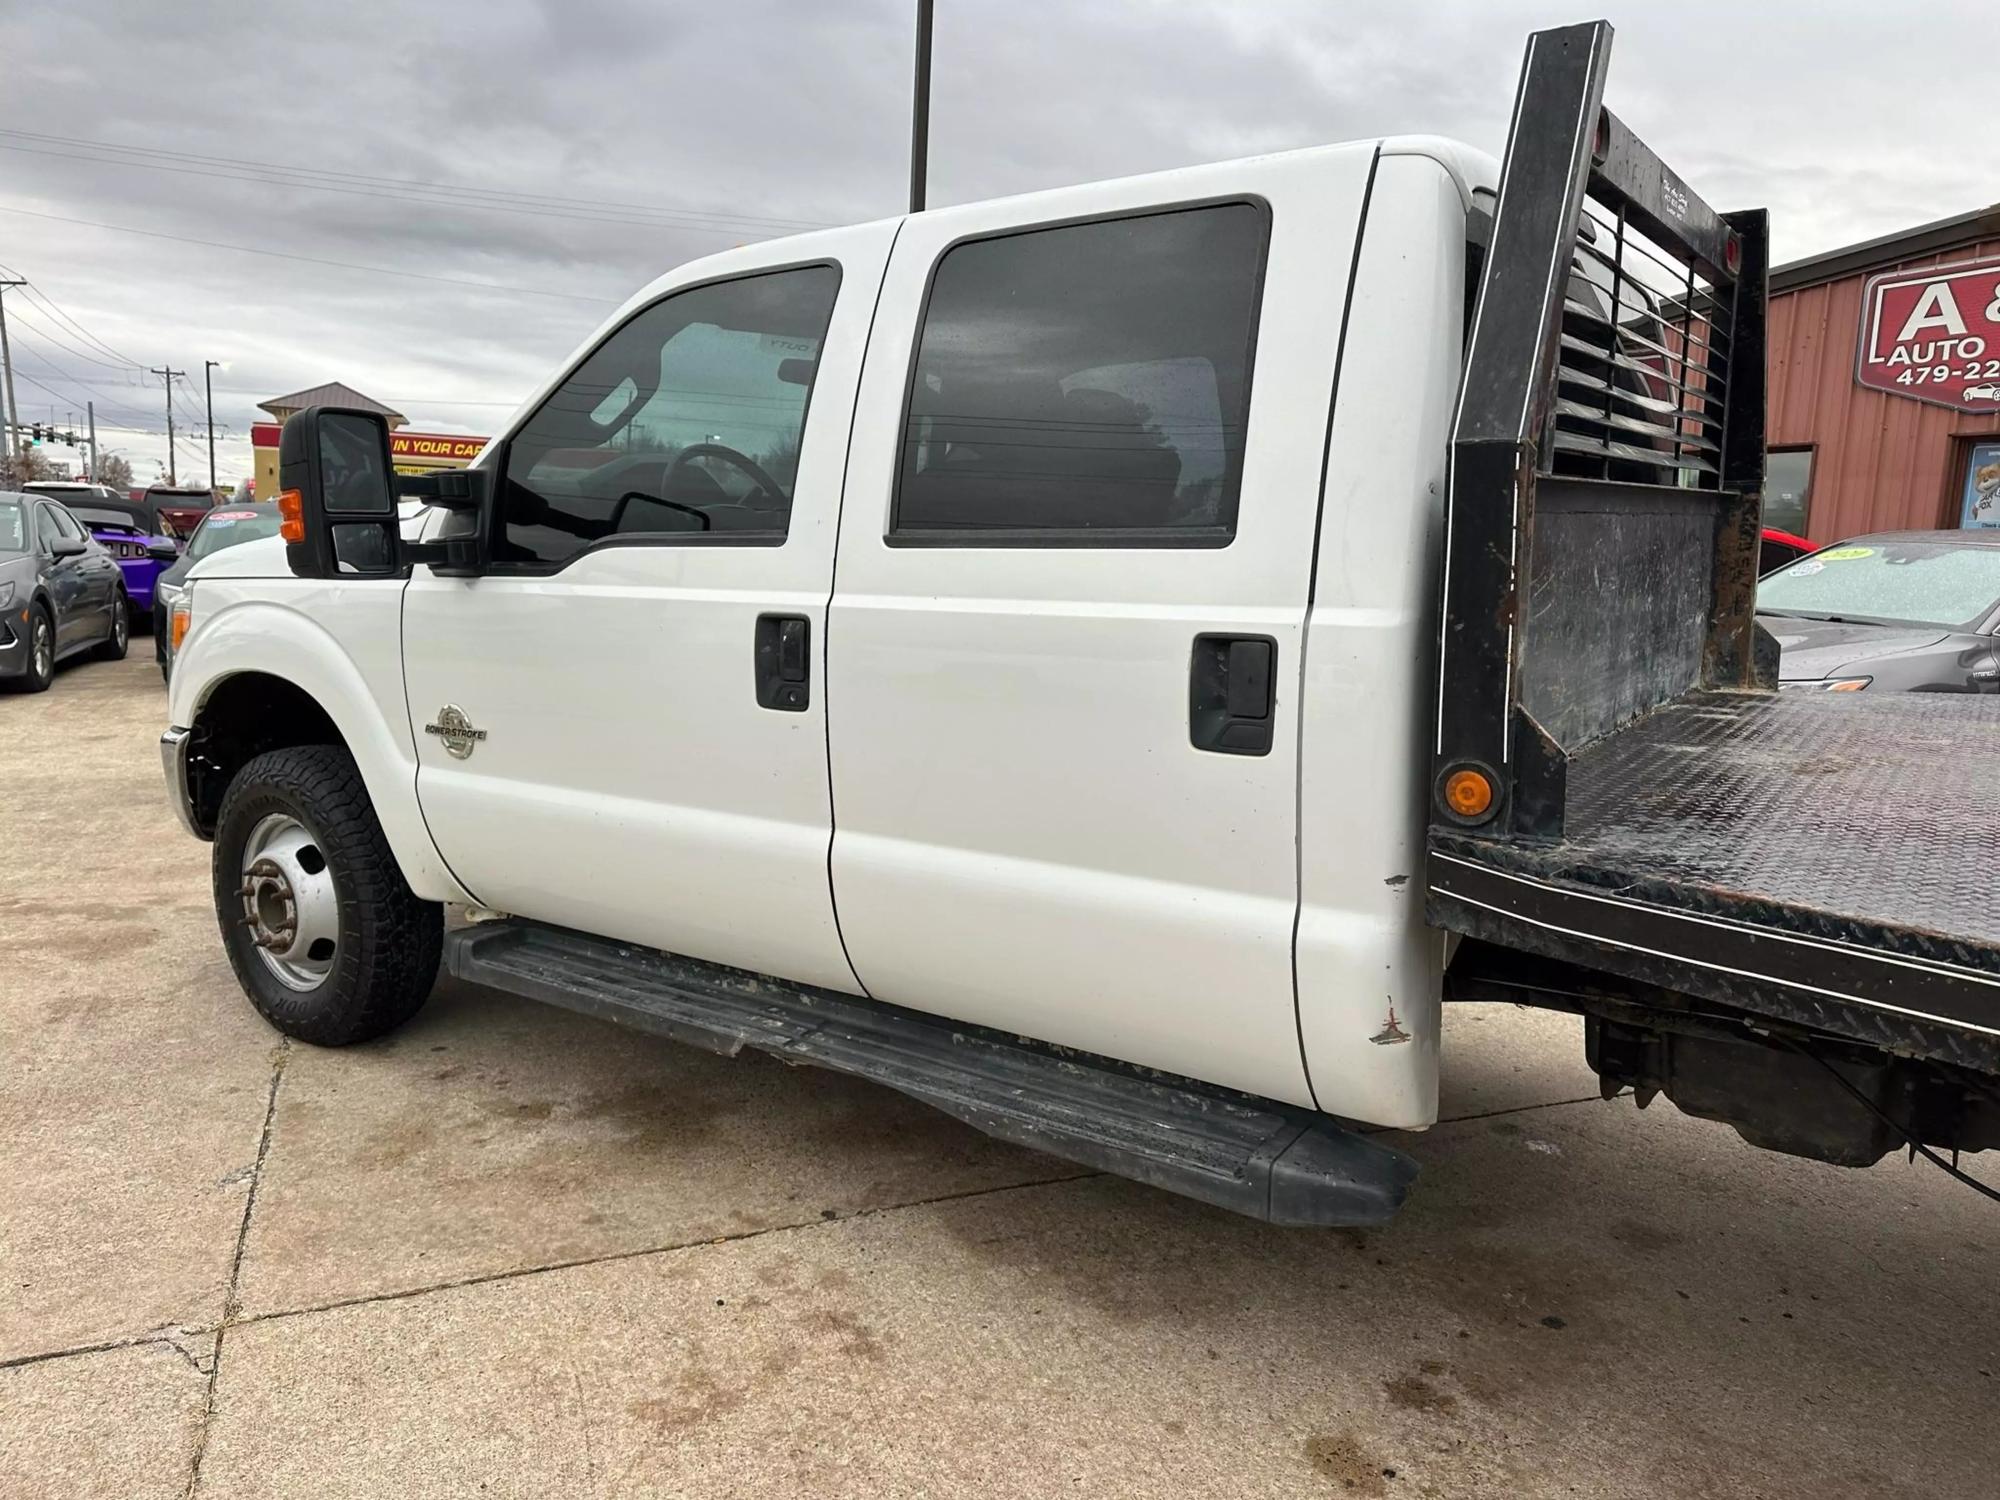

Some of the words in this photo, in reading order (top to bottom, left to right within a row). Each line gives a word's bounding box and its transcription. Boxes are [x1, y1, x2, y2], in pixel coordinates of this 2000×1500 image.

[1896, 281, 1968, 342] A
[1886, 336, 1985, 367] AUTO
[393, 439, 409, 452] IN
[412, 440, 452, 455] YOUR
